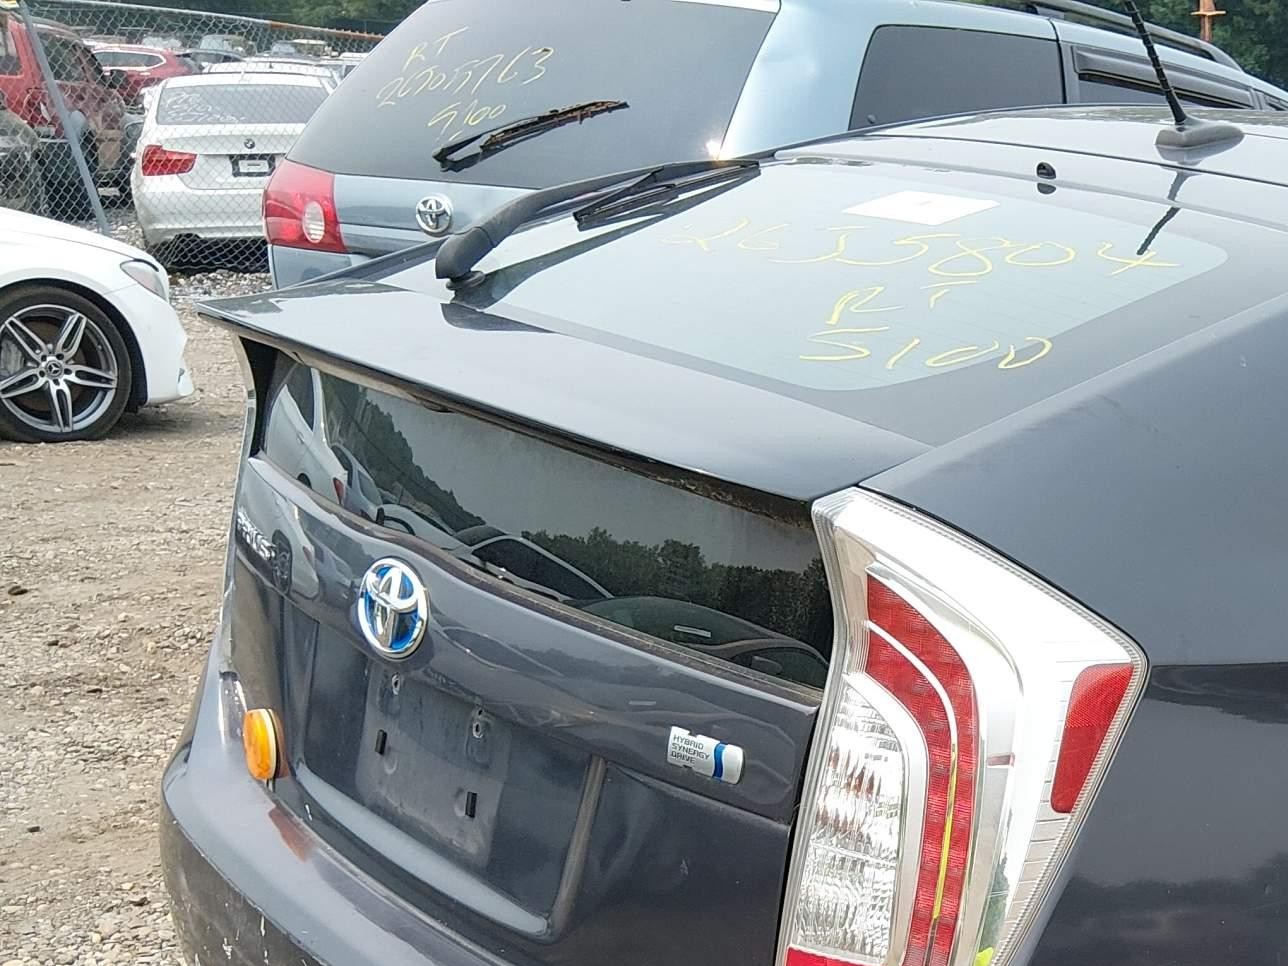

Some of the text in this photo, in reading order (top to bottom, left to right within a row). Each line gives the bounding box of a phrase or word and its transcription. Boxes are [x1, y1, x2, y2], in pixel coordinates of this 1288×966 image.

[673, 734, 704, 750] HYBRID
[670, 751, 697, 764] DRIVE
[671, 743, 711, 760] SYNERGY
